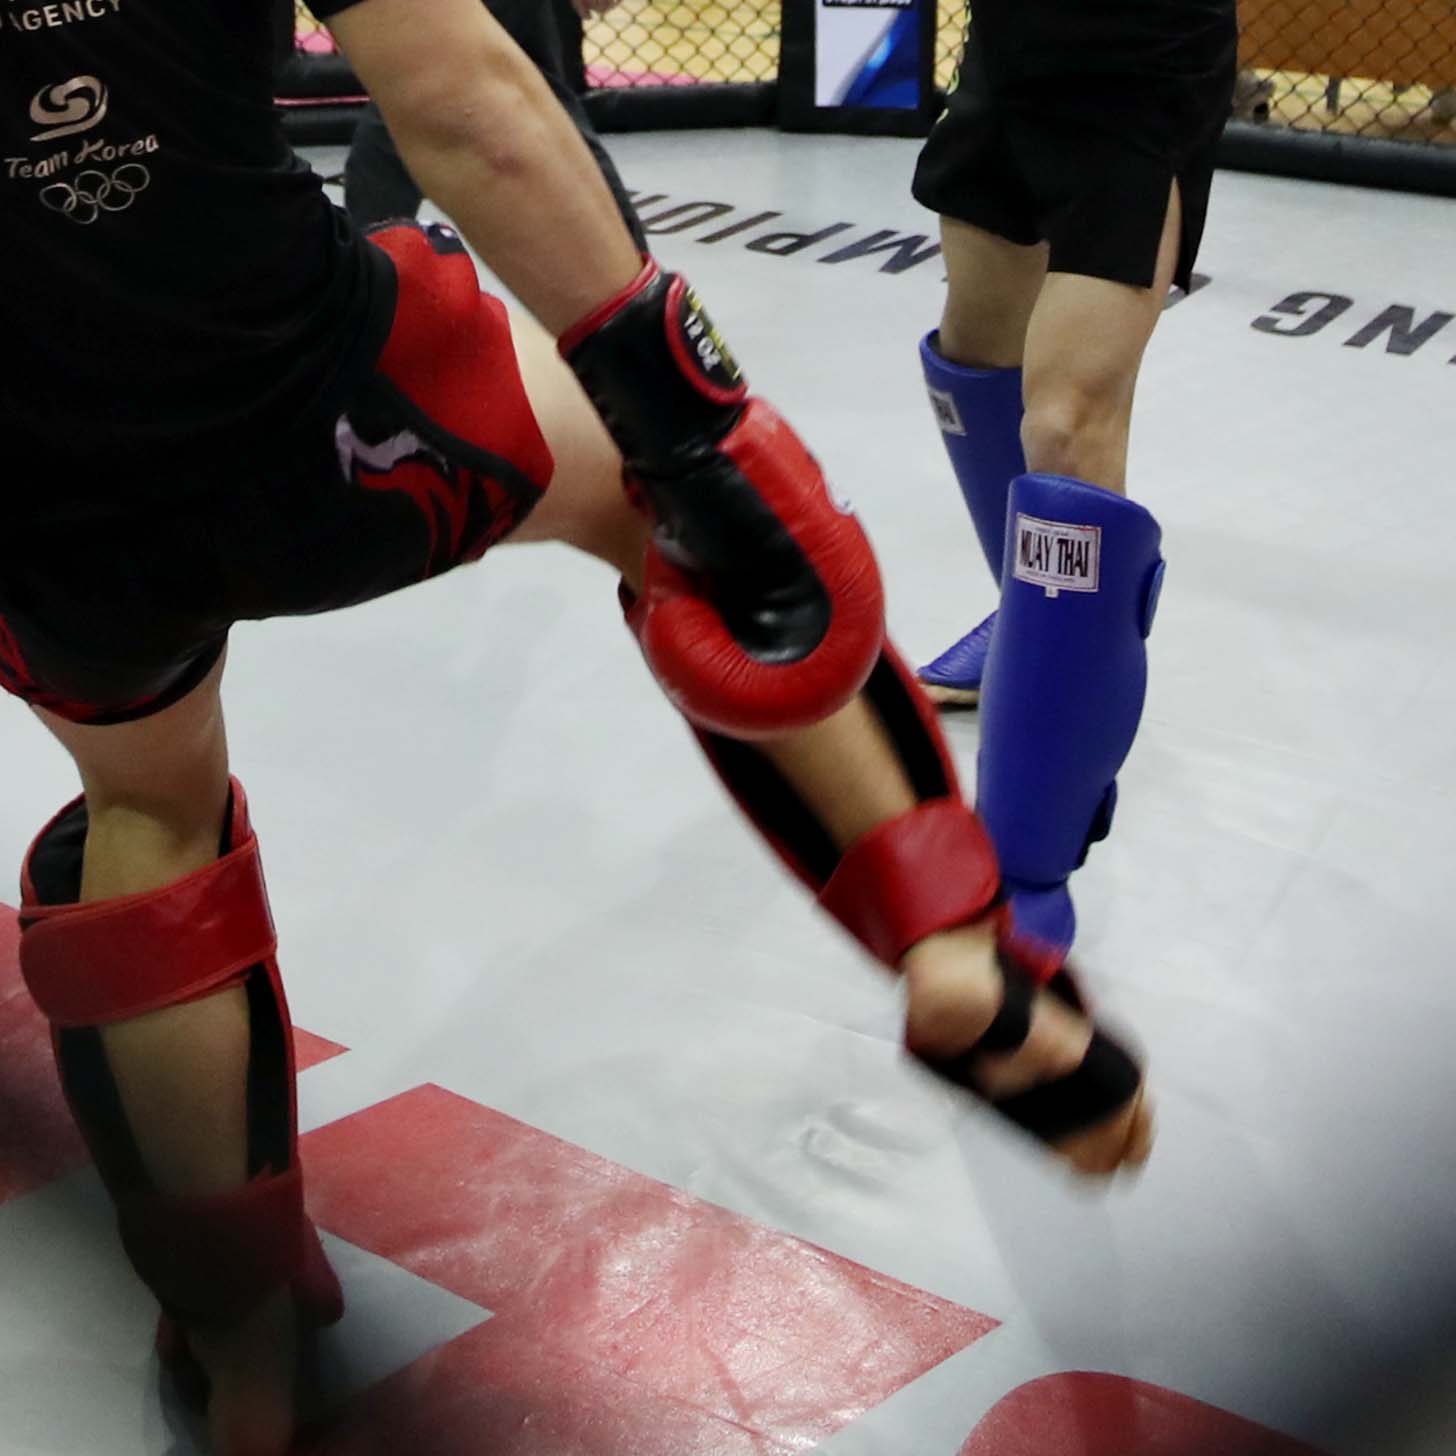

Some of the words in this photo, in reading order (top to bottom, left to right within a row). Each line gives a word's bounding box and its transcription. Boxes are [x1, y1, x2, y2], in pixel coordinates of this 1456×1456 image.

[3, 149, 70, 179] Team
[74, 134, 160, 165] Korea
[1056, 537, 1091, 578] THAI
